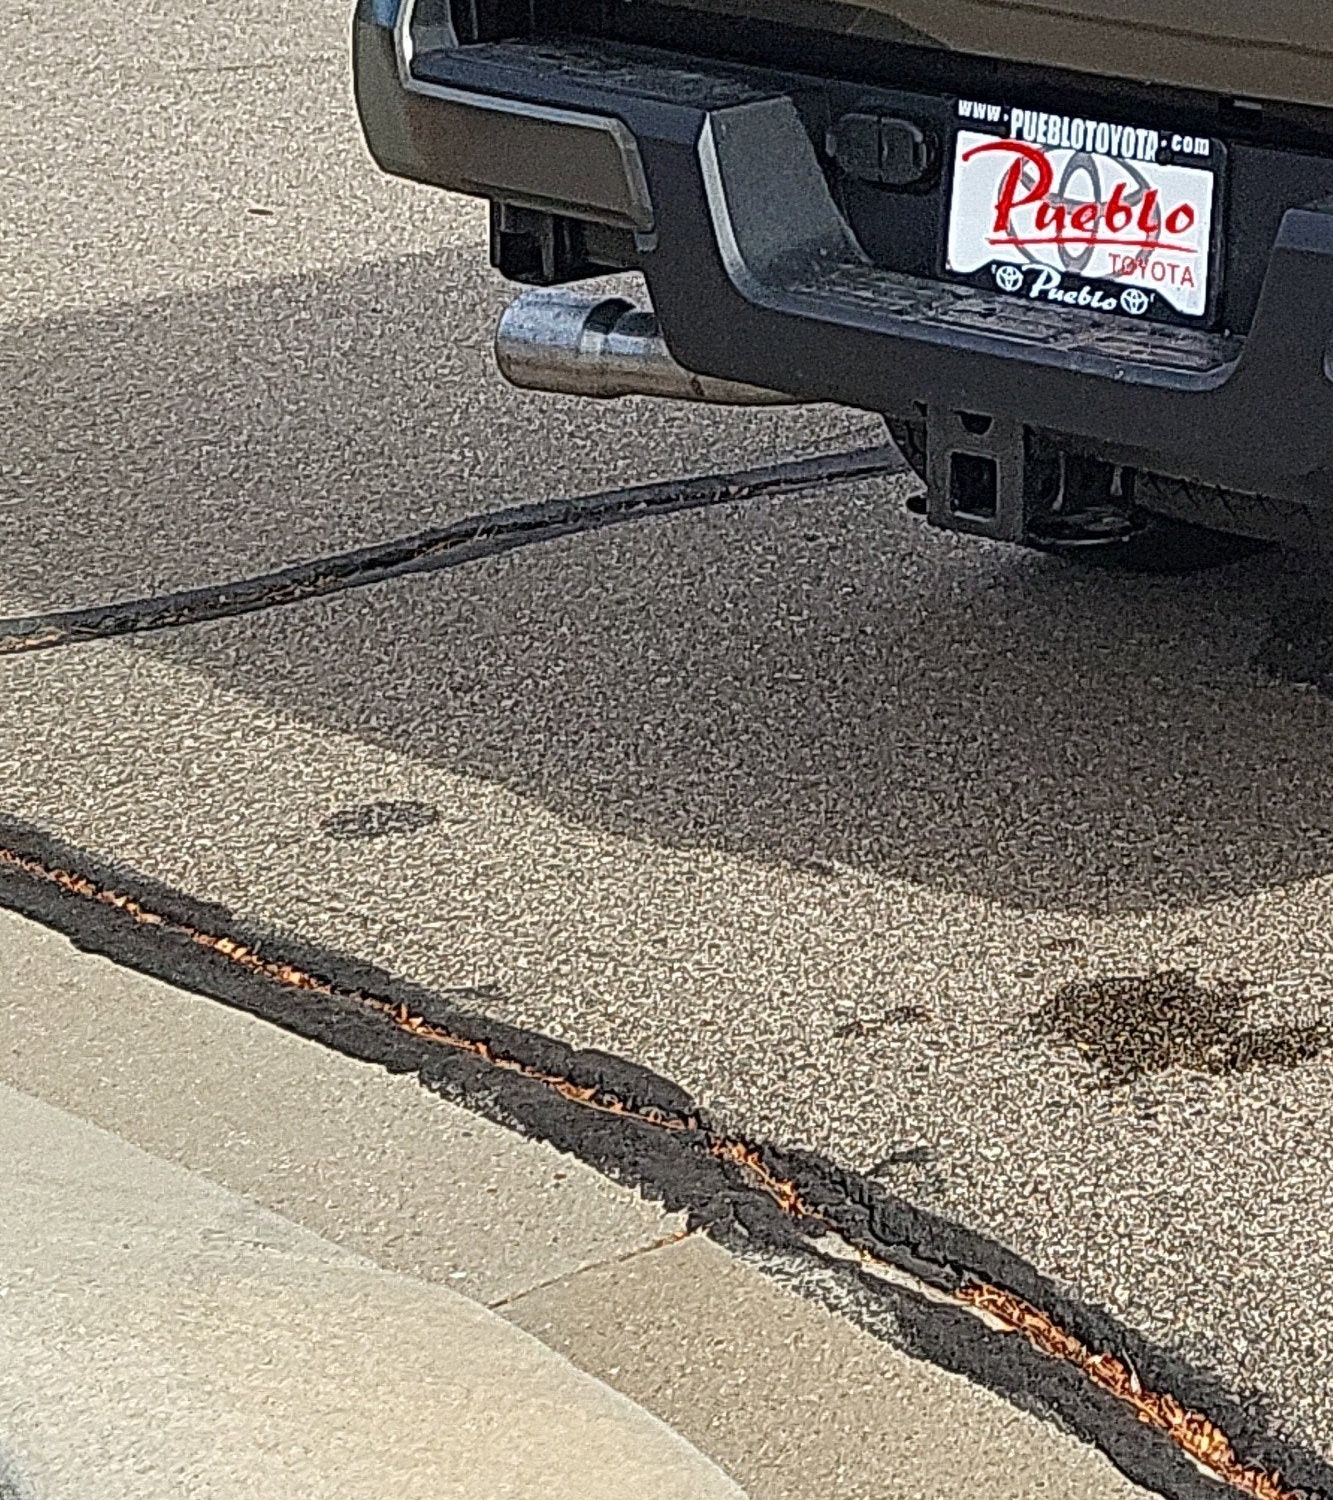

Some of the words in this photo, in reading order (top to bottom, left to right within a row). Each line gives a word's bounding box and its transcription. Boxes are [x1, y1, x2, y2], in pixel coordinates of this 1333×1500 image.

[962, 141, 1196, 234] Pueblo
[1023, 264, 1118, 311] Pueblo
[1108, 252, 1195, 288] TOYOTA
